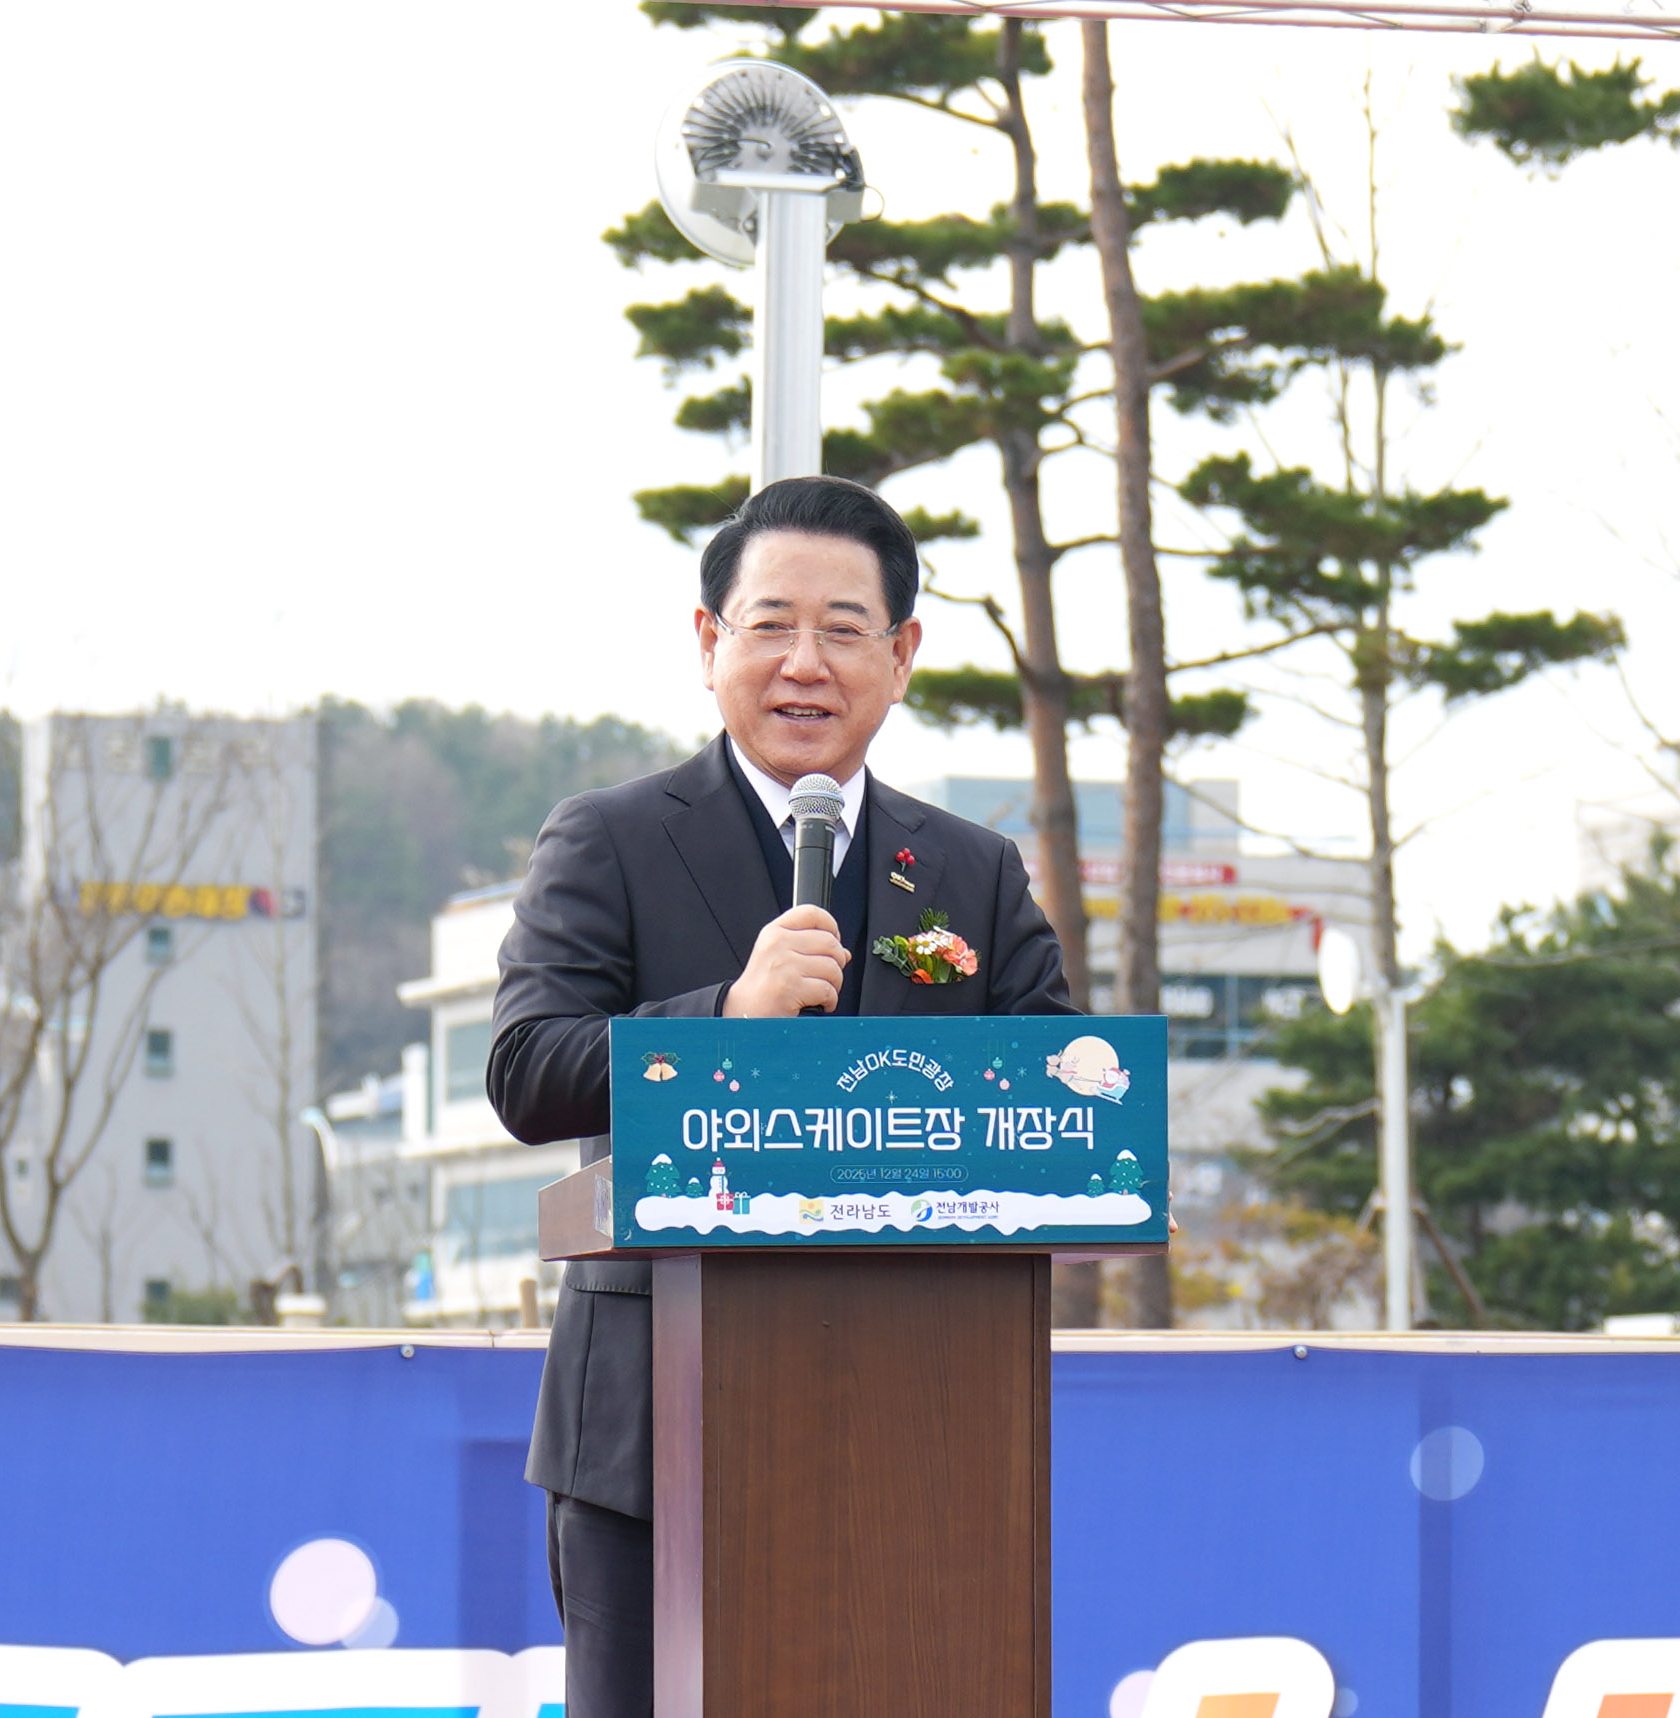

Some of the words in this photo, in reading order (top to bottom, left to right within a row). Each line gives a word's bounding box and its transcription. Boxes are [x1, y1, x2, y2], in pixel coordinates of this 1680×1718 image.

[835, 1049, 955, 1093] 전남OK도민광장
[681, 1106, 967, 1153] 야외스케이트장
[976, 1105, 1096, 1151] 개장식
[836, 1167, 877, 1181] 2025년
[879, 1166, 902, 1181] 12월
[904, 1167, 930, 1181] 24일
[830, 1203, 893, 1221] 전라남도
[935, 1200, 1000, 1214] 전남개발공사
